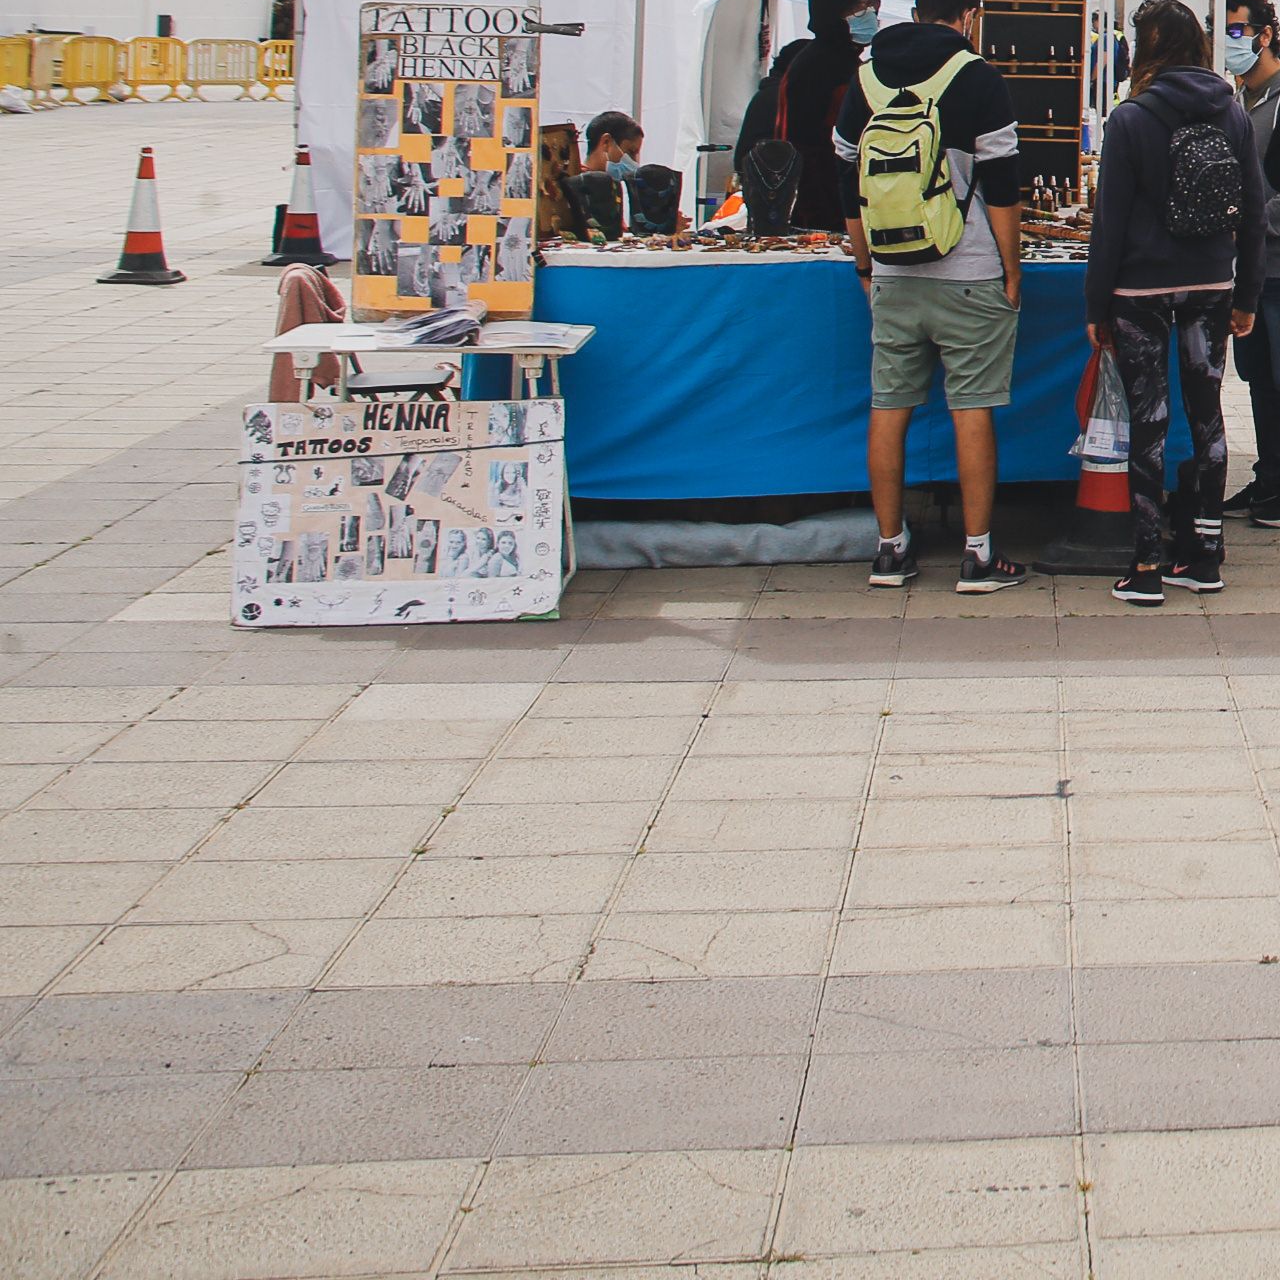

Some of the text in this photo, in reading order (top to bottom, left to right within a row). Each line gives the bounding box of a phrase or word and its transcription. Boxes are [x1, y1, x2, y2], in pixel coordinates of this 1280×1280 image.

[368, 7, 539, 34] TATTOOS
[402, 35, 496, 57] BLACK
[400, 57, 498, 80] HENNA
[363, 403, 450, 432] HENNA
[276, 436, 374, 457] TATTOOS
